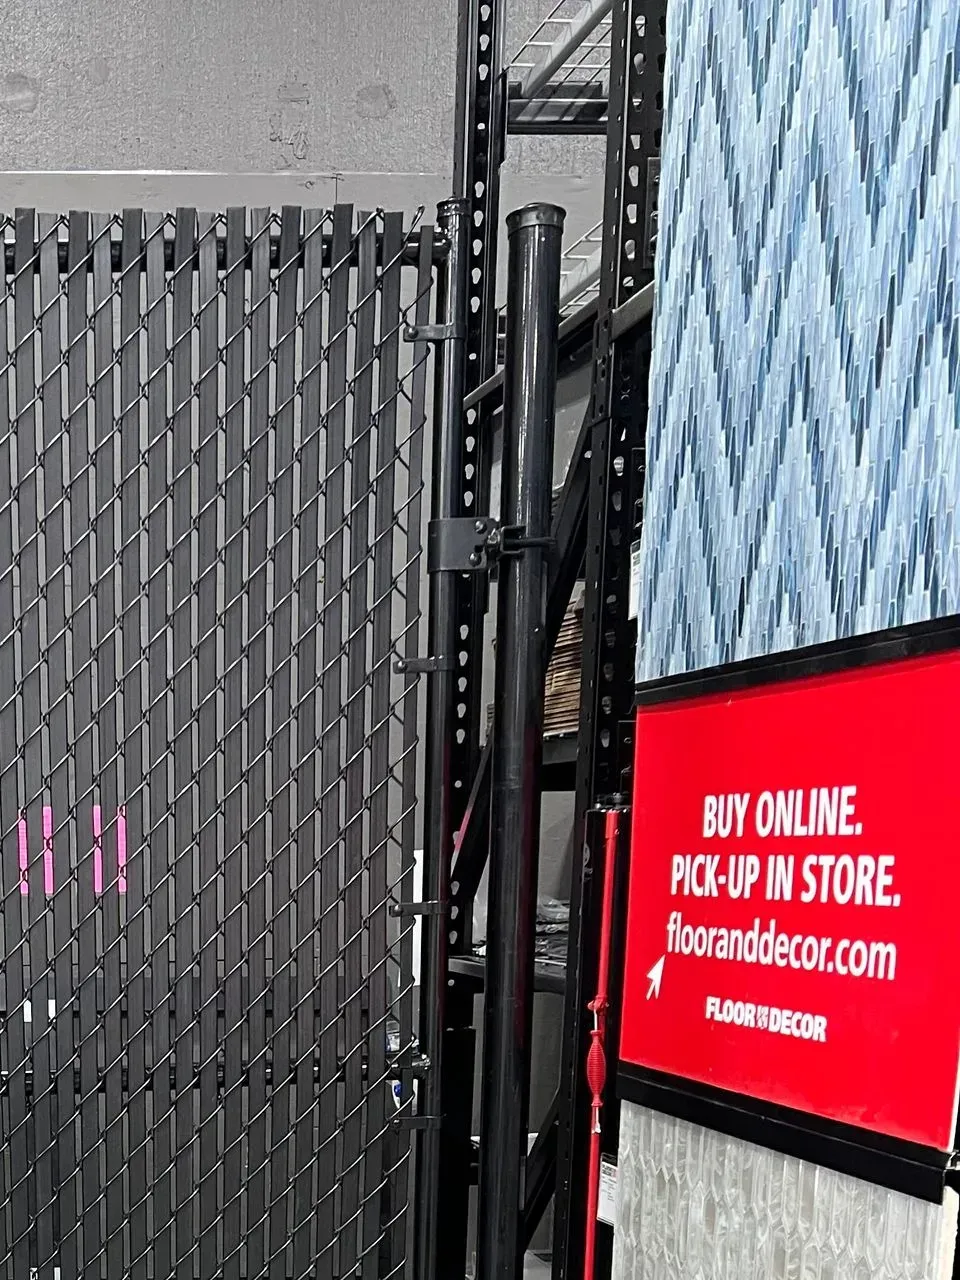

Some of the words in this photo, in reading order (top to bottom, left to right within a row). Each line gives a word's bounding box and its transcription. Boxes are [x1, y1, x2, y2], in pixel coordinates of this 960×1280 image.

[702, 792, 751, 838] BUY
[755, 785, 863, 838] ONLINE.
[670, 854, 761, 900] PICK-UP
[765, 854, 795, 901] IN
[800, 854, 902, 908] STORE.
[666, 910, 898, 981] flooranddecor.com
[705, 995, 757, 1029] FLOOR
[768, 1006, 828, 1043] DECOR
